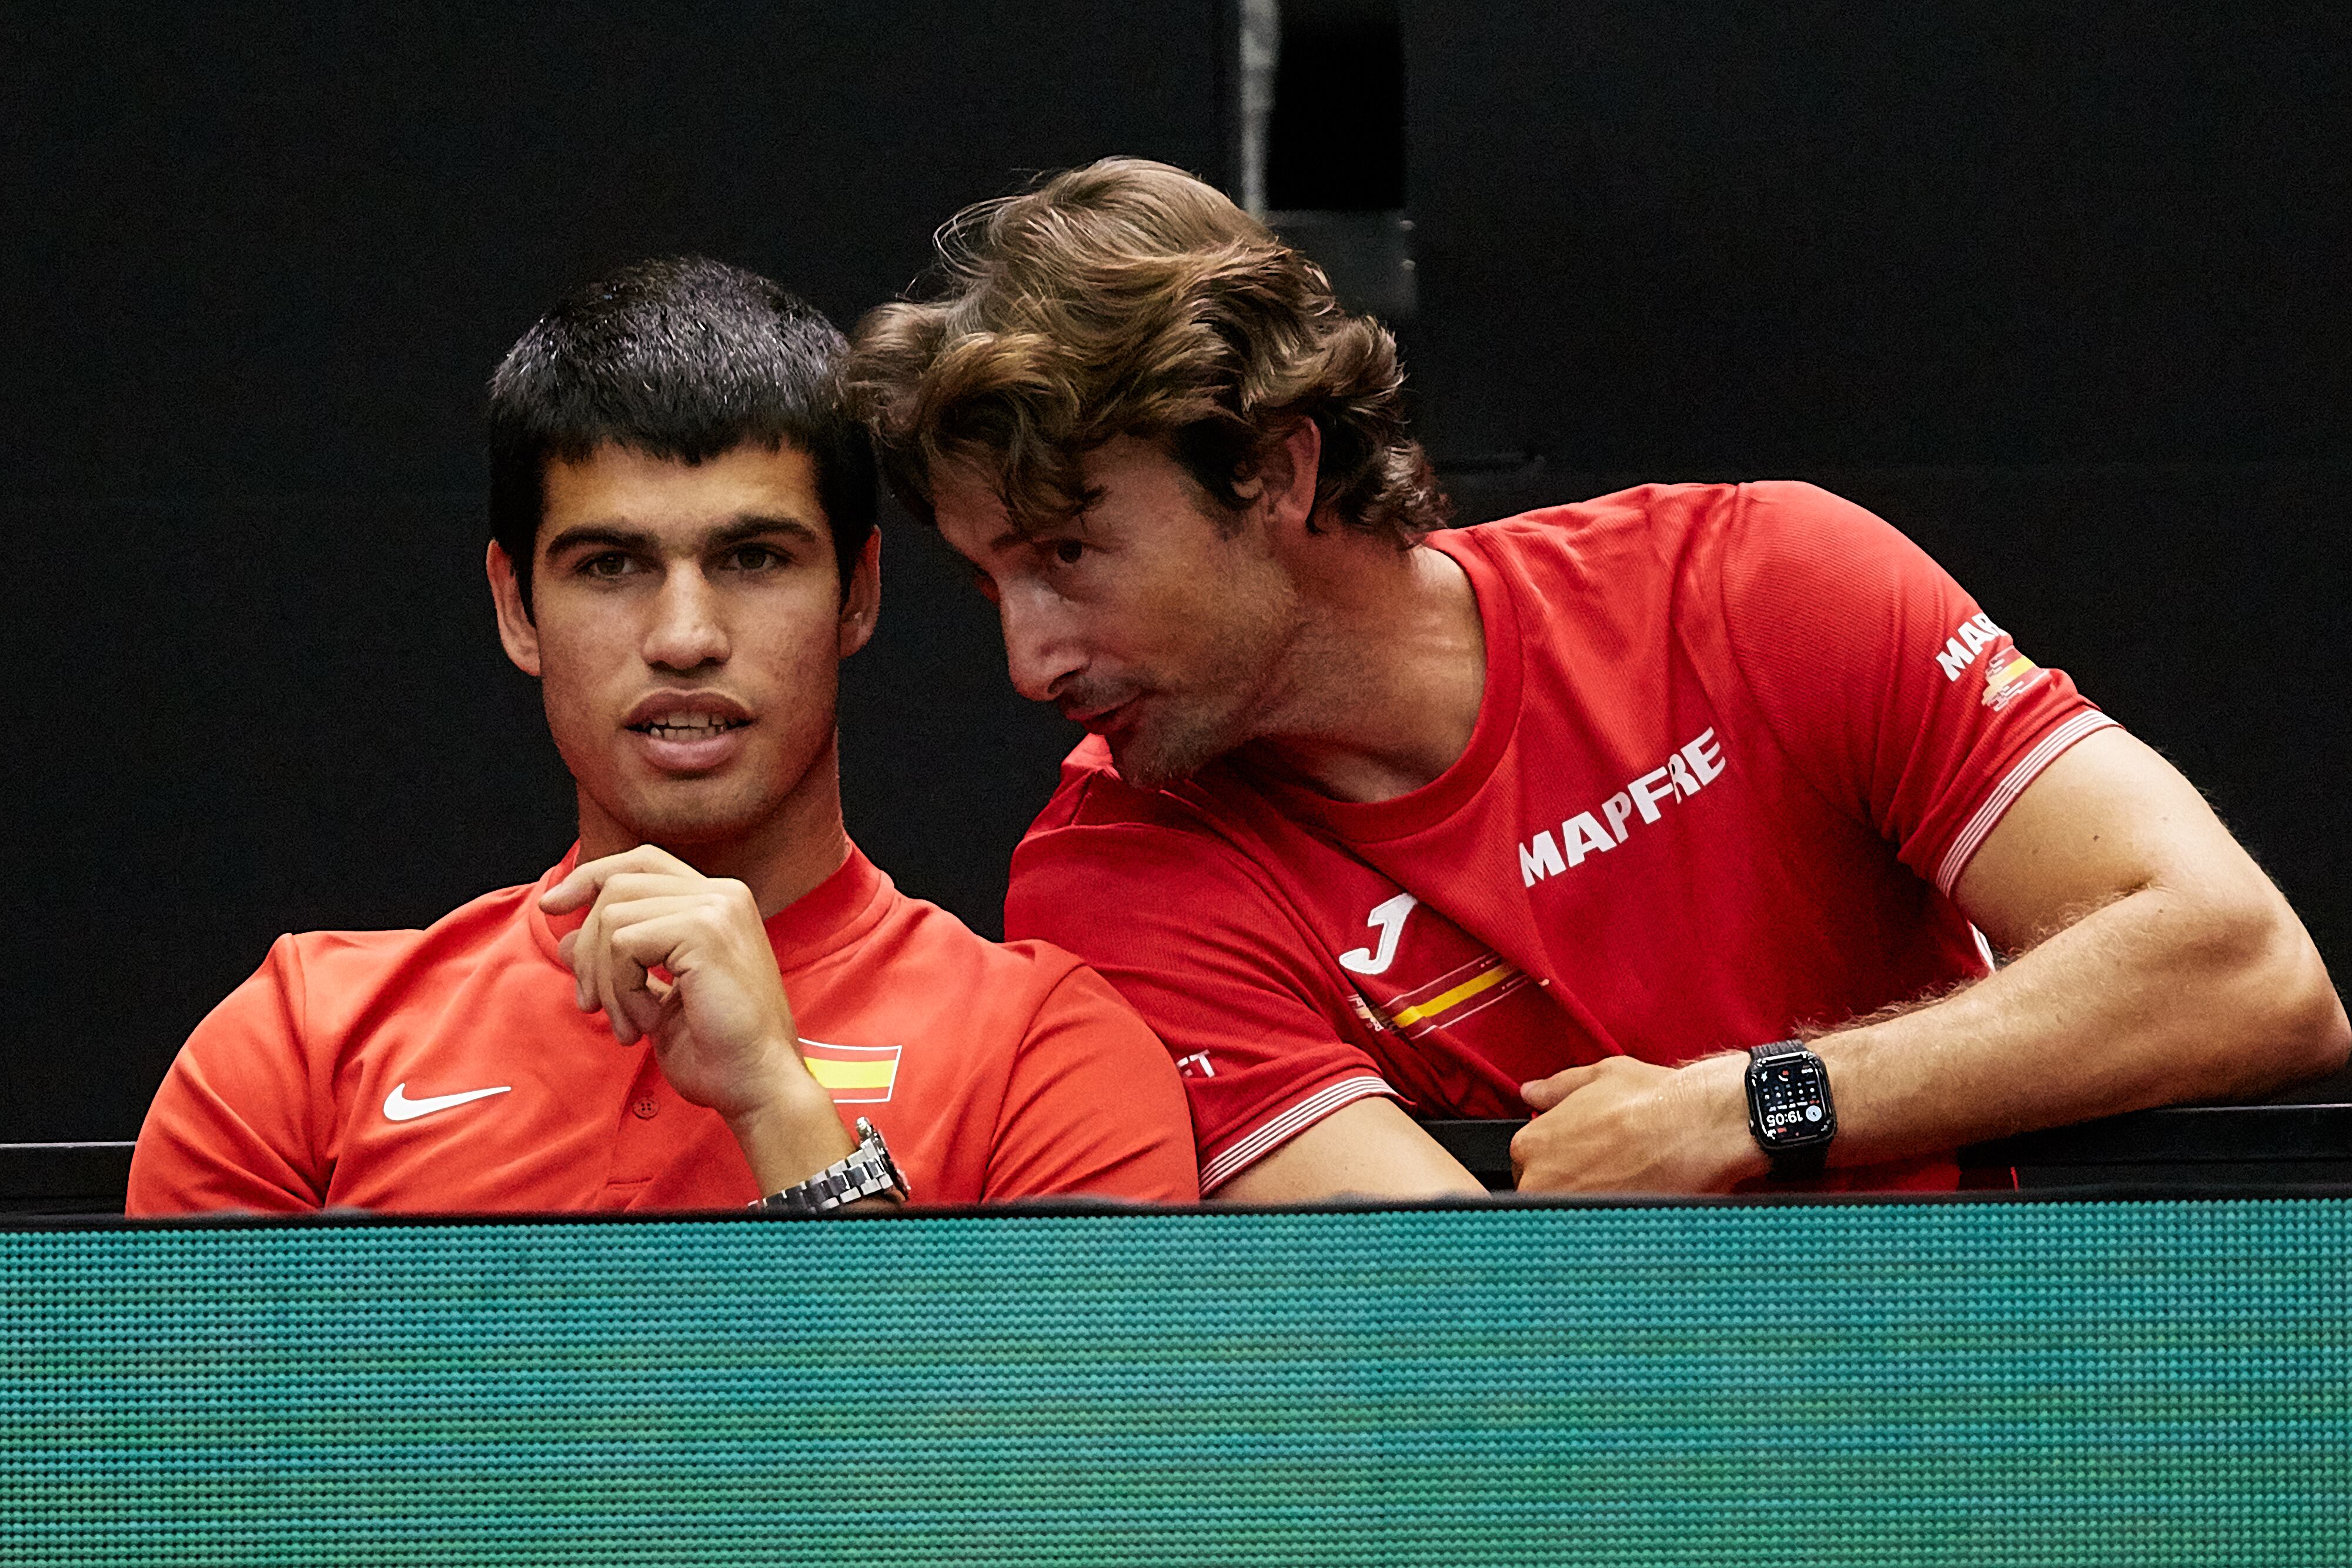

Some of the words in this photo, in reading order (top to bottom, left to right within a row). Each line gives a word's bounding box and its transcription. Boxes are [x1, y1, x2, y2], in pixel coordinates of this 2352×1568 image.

[1936, 612, 2009, 681] MAP
[1519, 727, 1726, 888] MAPFRE
[1766, 1110, 1803, 1127] 19:05
